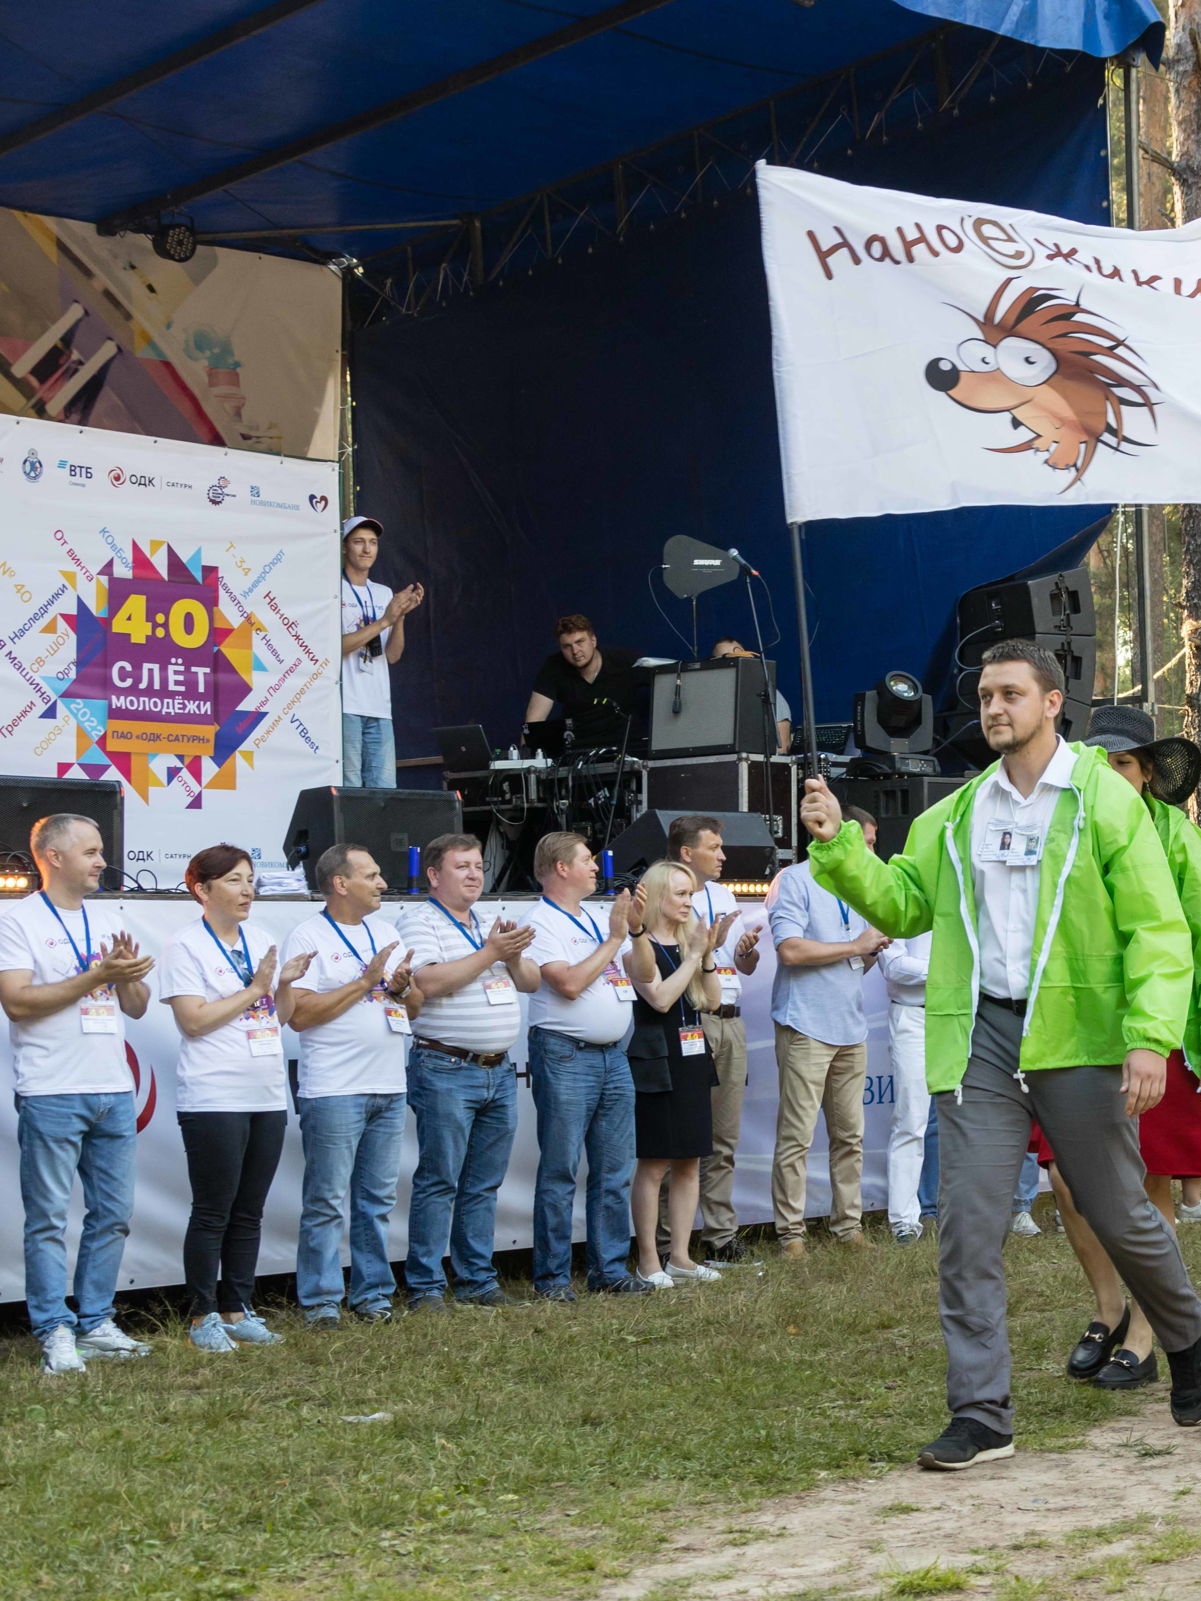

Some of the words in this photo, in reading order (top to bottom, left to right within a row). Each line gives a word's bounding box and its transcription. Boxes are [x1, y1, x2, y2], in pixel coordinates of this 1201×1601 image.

[69, 464, 93, 479] ВТБ
[129, 474, 155, 487] ОДК
[165, 480, 193, 490] САТУРН
[53, 529, 69, 547] От
[66, 547, 95, 583] винта
[8, 583, 69, 645] Наследники
[111, 594, 210, 649] 4:0
[217, 575, 256, 628] Авиаторы
[260, 634, 285, 665] Невы
[4, 650, 52, 705] машина
[111, 657, 211, 693] СЛЁТ
[70, 699, 105, 740] 2022
[111, 695, 212, 716] МОЛОДЁЖИ
[253, 715, 284, 749] Режим
[282, 658, 330, 716] секретности
[111, 730, 133, 741] ПАО
[135, 732, 210, 745] «ОДК-САТУРН»
[290, 713, 319, 754] VTBest
[127, 850, 154, 863] ОДК
